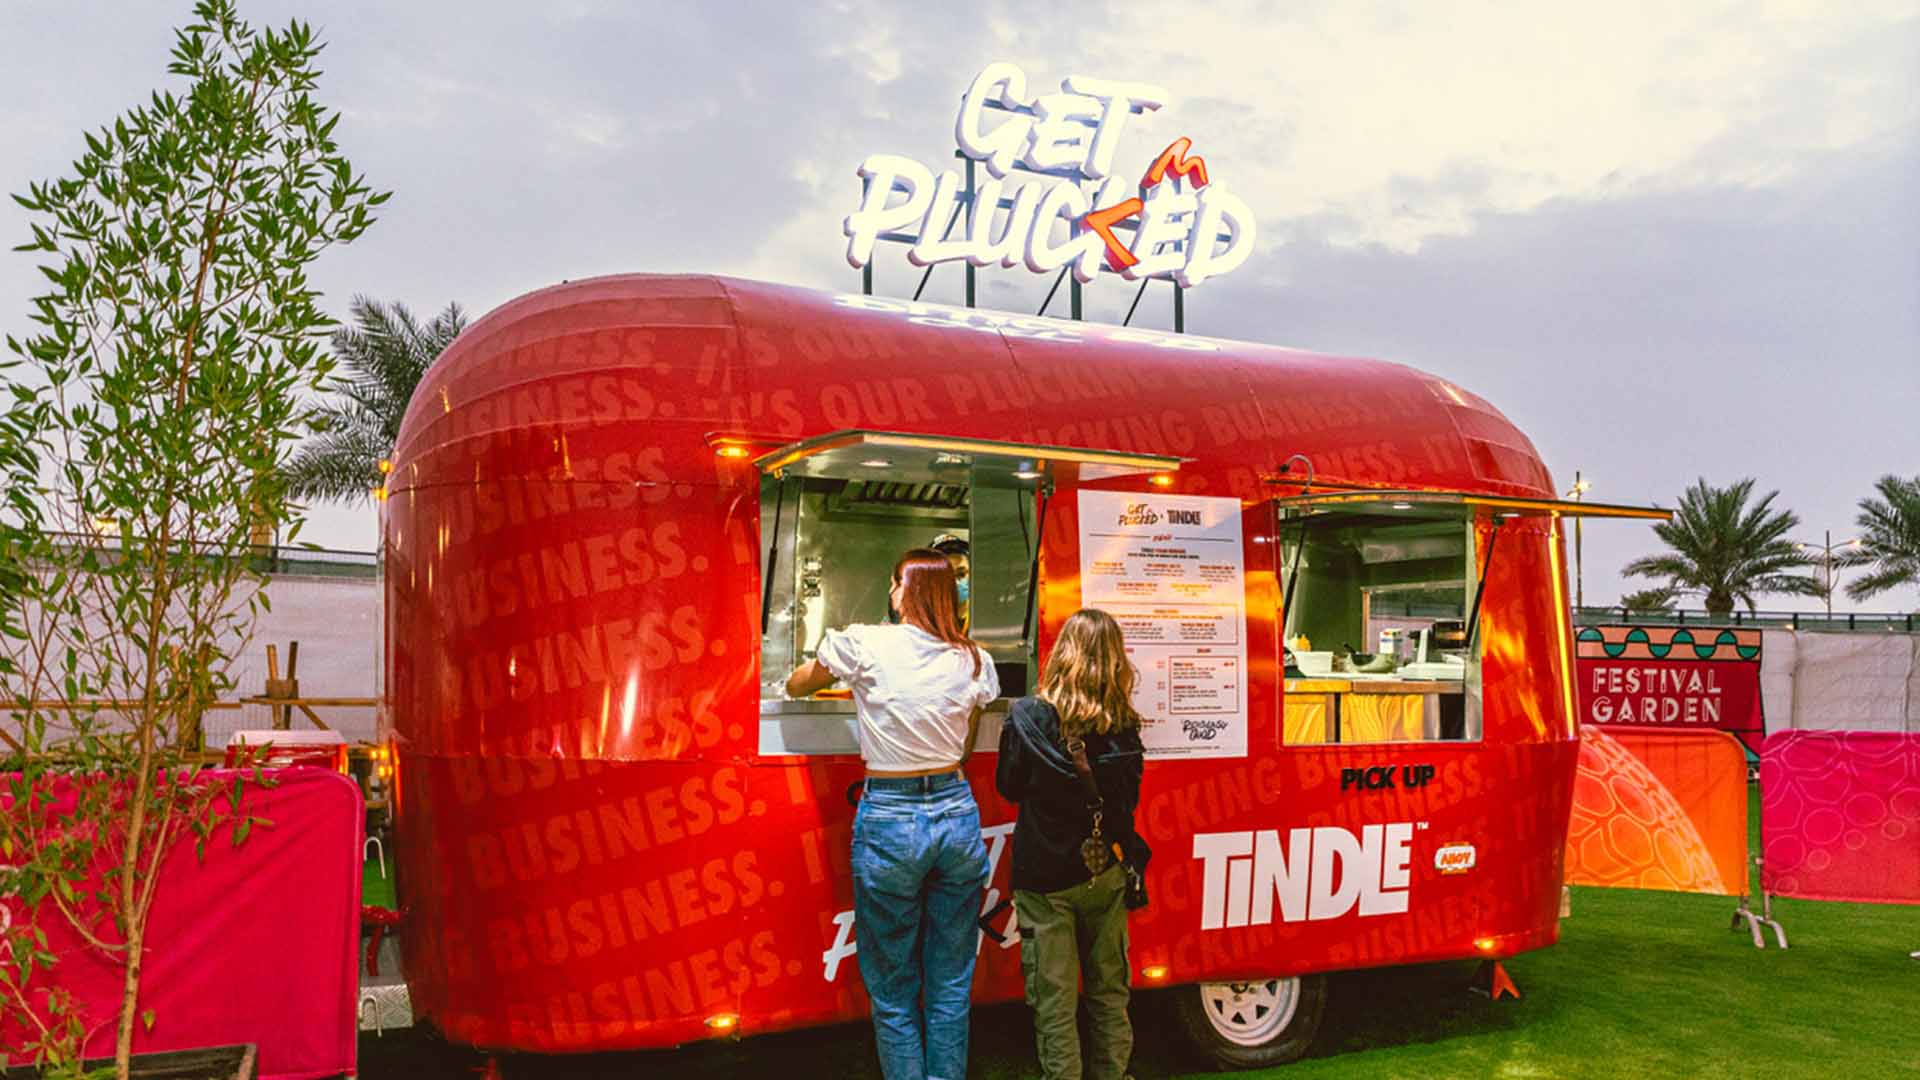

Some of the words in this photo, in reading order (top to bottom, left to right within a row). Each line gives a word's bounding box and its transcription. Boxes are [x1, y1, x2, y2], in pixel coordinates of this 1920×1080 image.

[956, 62, 1169, 180] GET
[843, 140, 1257, 288] PLUCKED
[819, 378, 938, 430] OUR
[1591, 696, 1722, 722] GARDEN
[1592, 666, 1722, 694] FESTIVAL
[1341, 765, 1396, 791] PICK
[1402, 764, 1435, 788] UP
[467, 766, 767, 886] BUSINESS.
[489, 849, 784, 970] BUSINESS.
